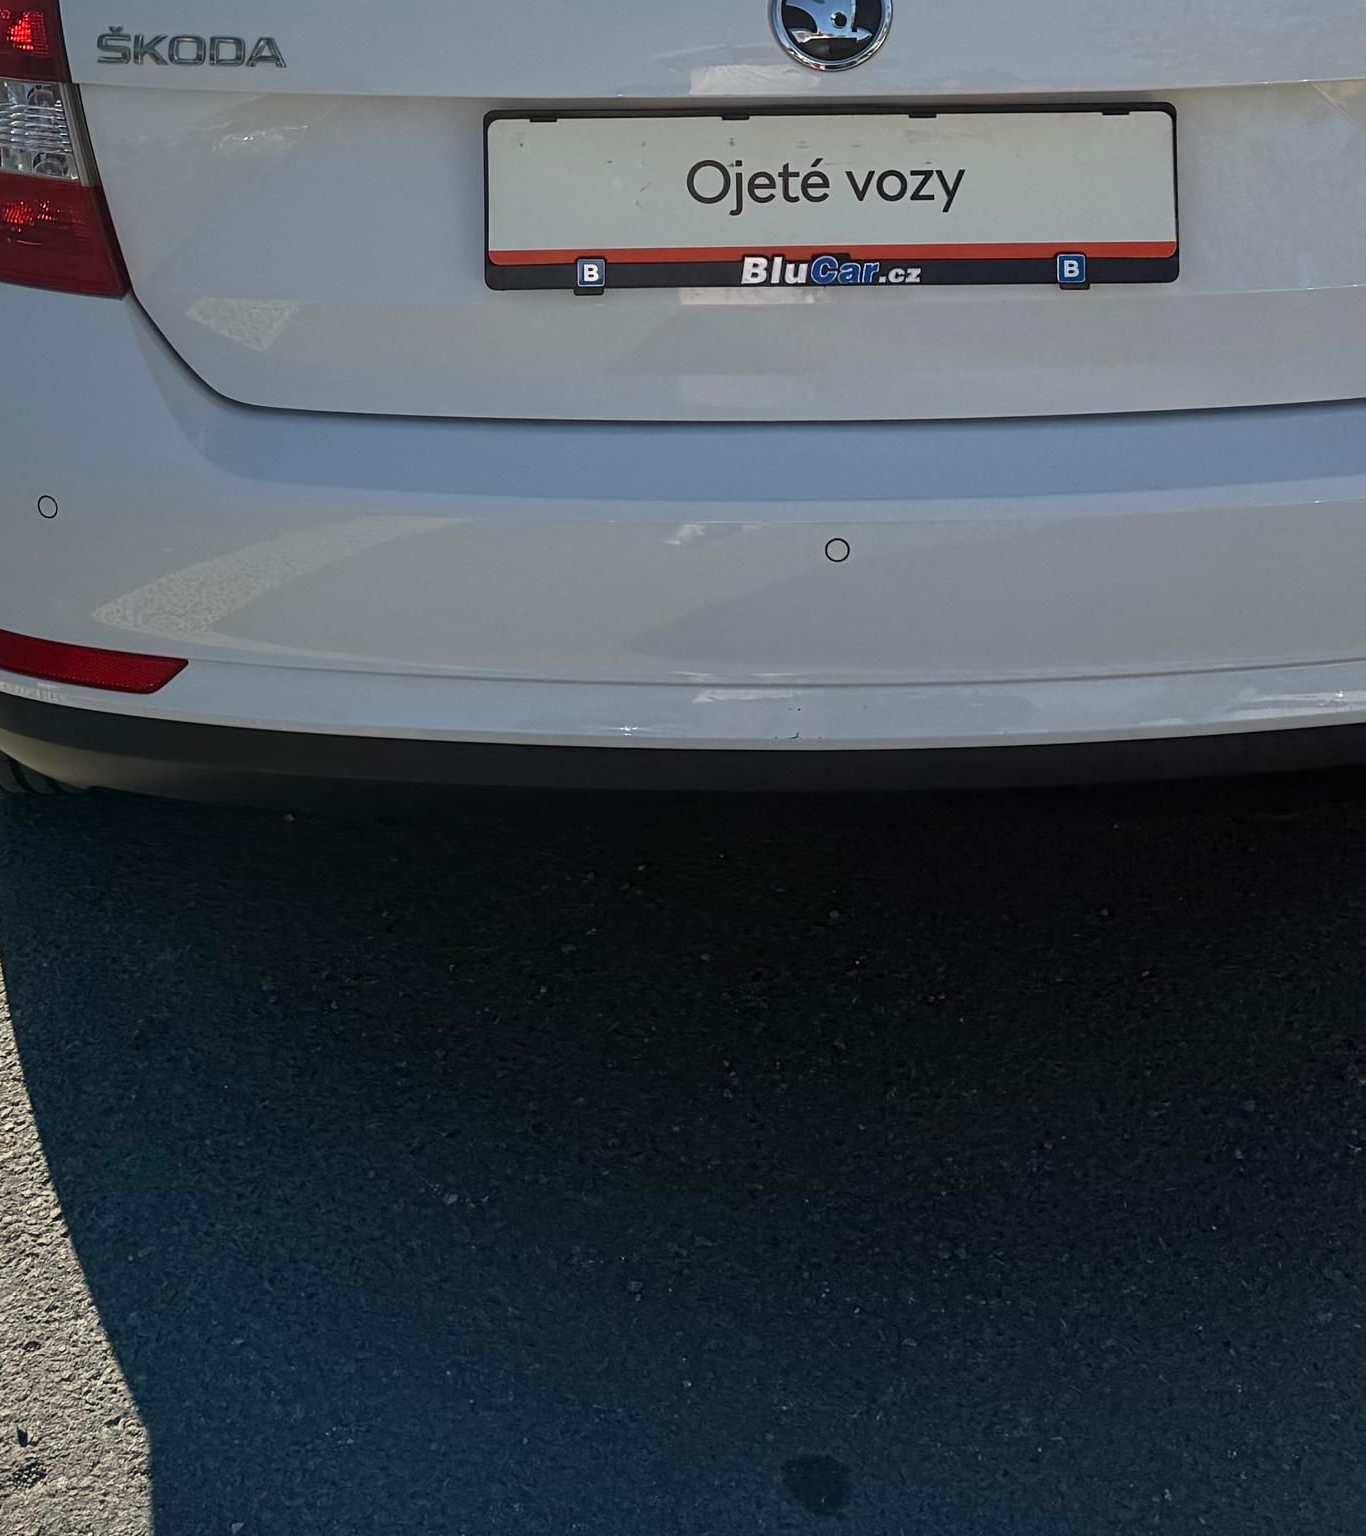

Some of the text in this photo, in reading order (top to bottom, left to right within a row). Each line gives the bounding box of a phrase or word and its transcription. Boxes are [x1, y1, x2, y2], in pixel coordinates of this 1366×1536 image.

[96, 25, 288, 69] ŠKODA
[686, 157, 966, 216] Ojeté vozy
[583, 263, 600, 282] B
[741, 254, 922, 286] BluCar.cz
[1063, 260, 1080, 279] B
